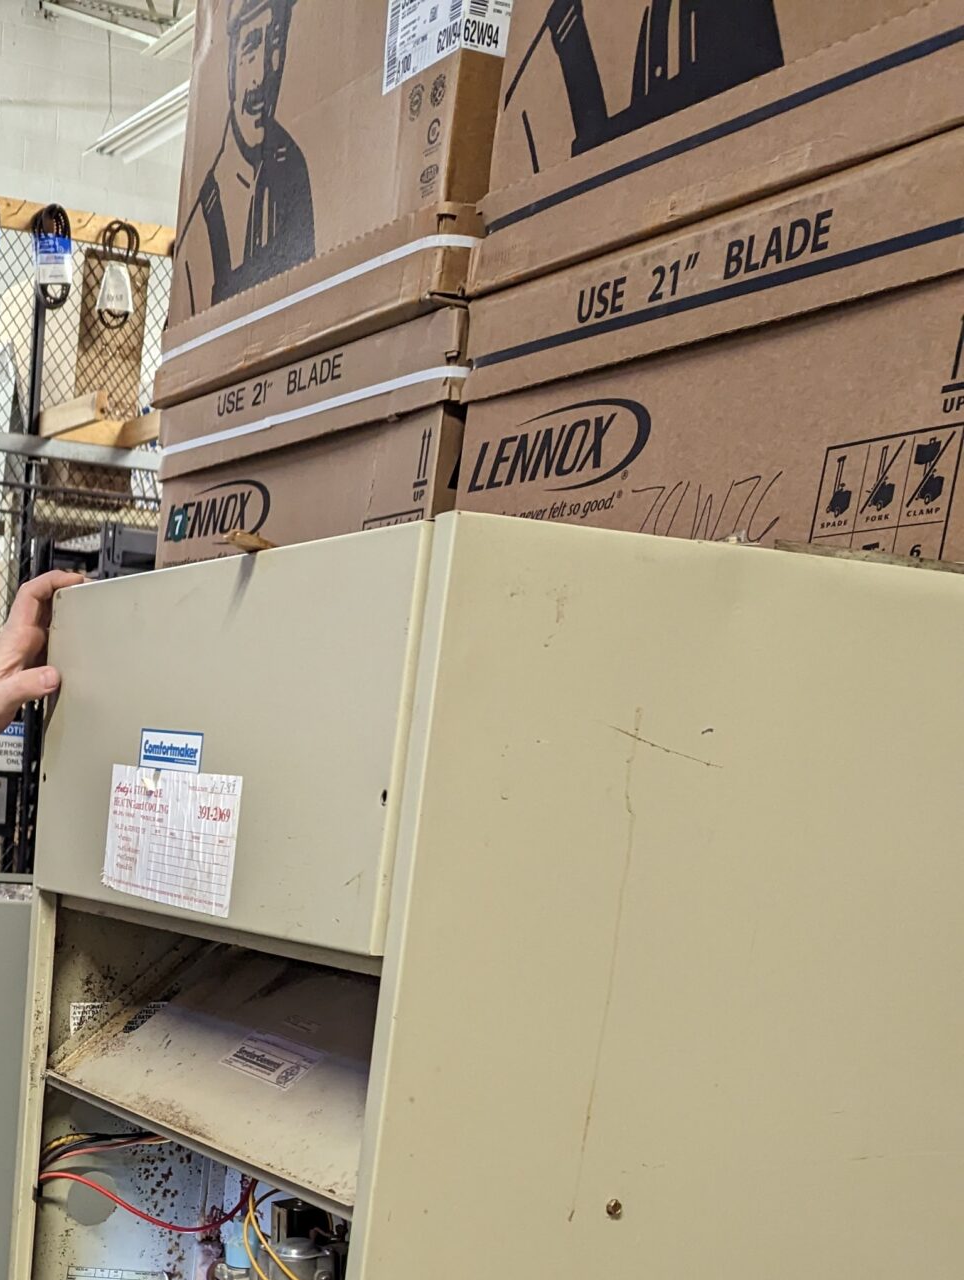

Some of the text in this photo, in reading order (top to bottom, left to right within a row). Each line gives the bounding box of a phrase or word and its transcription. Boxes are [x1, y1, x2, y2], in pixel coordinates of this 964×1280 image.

[437, 19, 461, 53] 62W94
[463, 19, 499, 48] 62W94
[578, 277, 626, 323] USE
[724, 209, 833, 280] BLADE
[217, 387, 244, 416] USE
[287, 353, 343, 395] BLADE
[943, 396, 964, 413] UP
[468, 412, 617, 492] LENNOX
[413, 491, 424, 502] UP
[548, 501, 566, 519] felt
[568, 502, 580, 516] so
[865, 514, 889, 523] FORK
[906, 508, 940, 517] CLAMP
[173, 515, 183, 535] 7
[821, 520, 848, 529] SPADE
[144, 740, 198, 758] Comfortmaker
